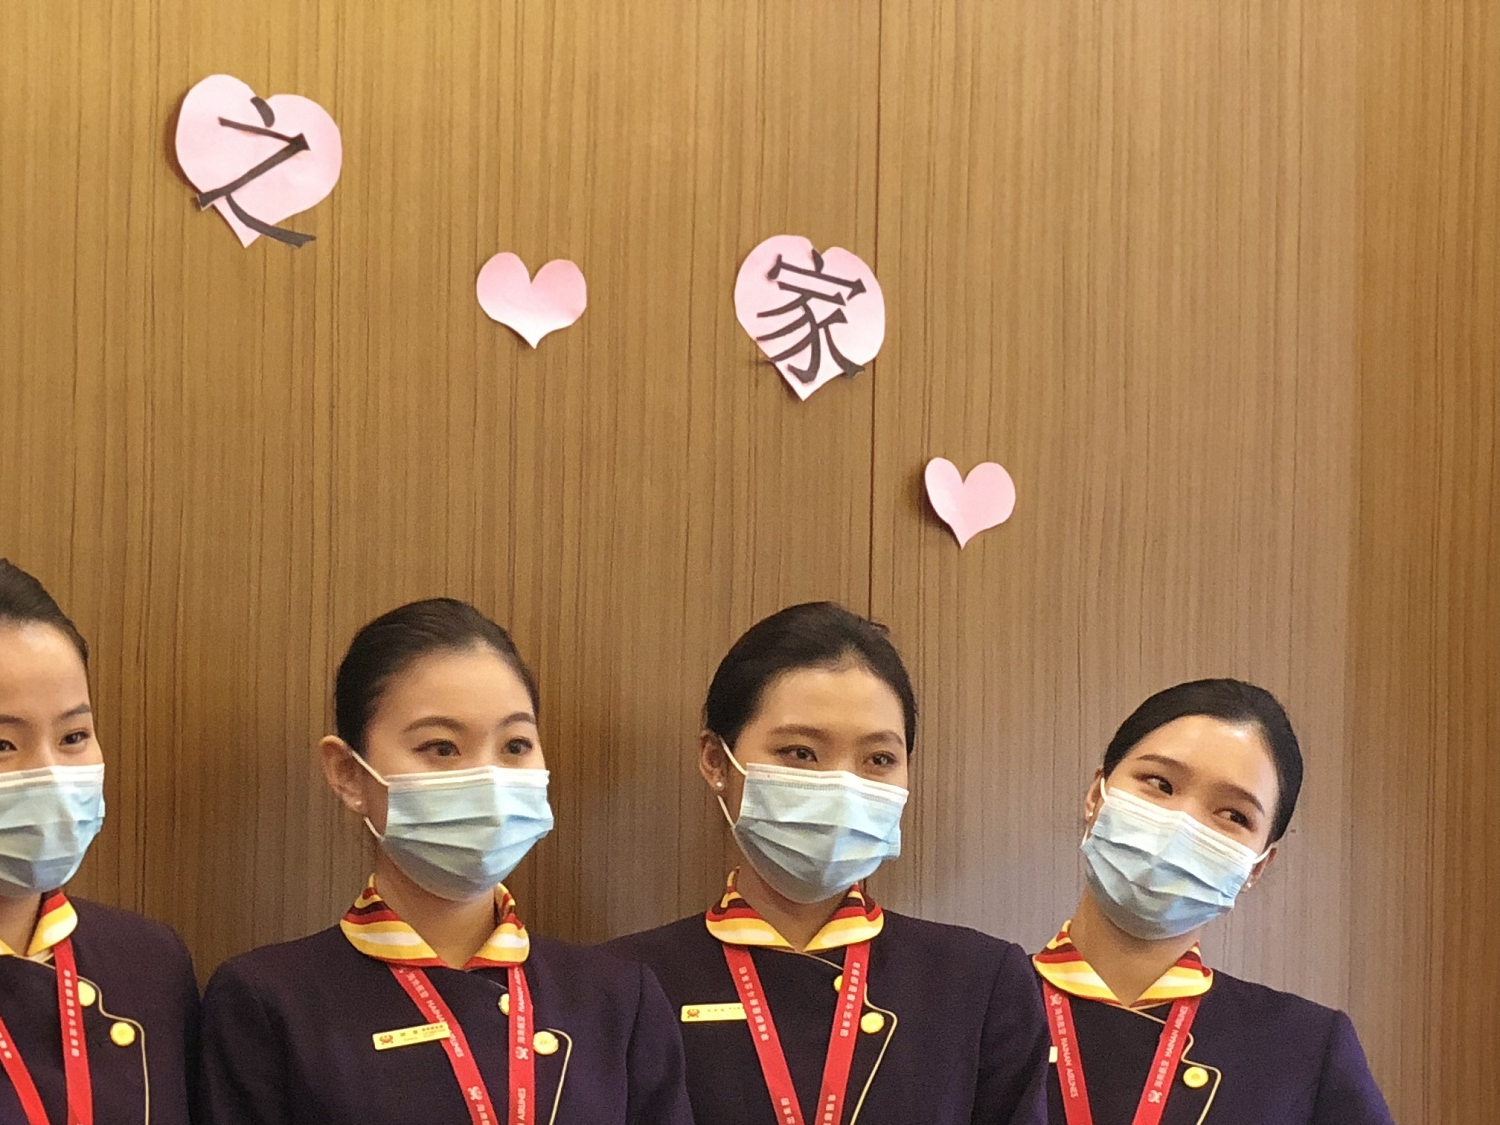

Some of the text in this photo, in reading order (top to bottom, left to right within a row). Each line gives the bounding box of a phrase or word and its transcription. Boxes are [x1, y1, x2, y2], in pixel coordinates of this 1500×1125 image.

[194, 96, 317, 248] 之
[756, 249, 866, 383] 家
[1059, 1037, 1073, 1068] HAINAN
[1164, 1028, 1180, 1058] HAINAN
[517, 1087, 527, 1122] AIRLINES
